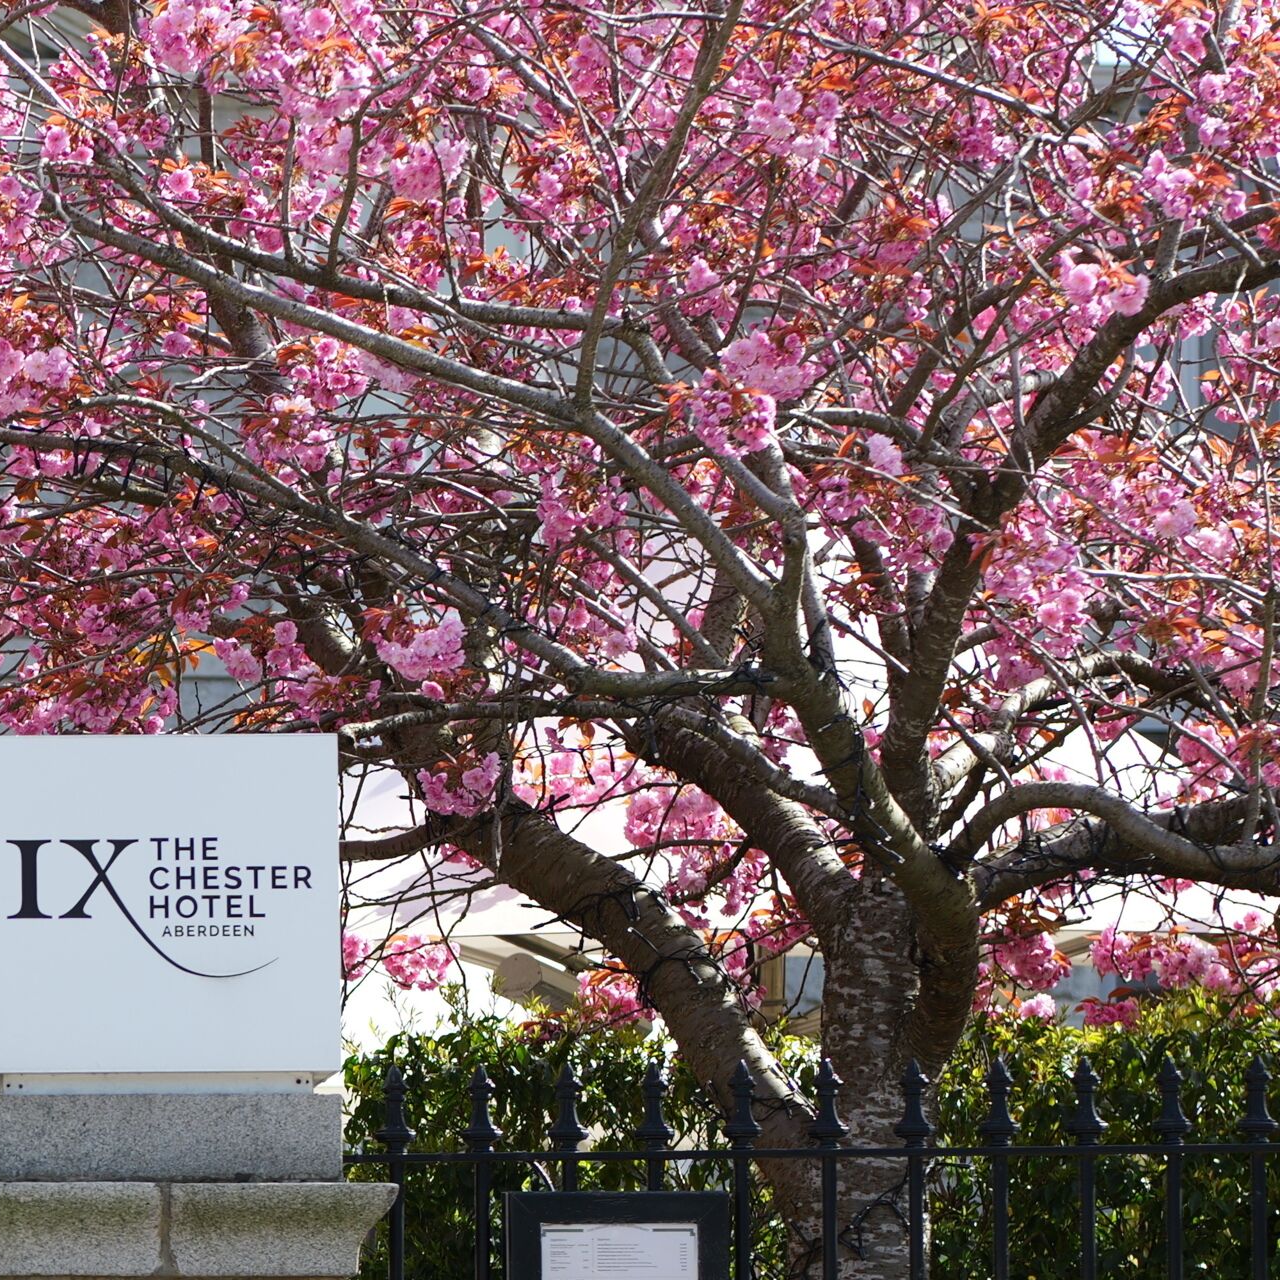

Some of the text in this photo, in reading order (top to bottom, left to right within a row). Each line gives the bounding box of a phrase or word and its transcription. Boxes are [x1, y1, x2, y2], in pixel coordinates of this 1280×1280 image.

[149, 836, 219, 861] THE
[149, 865, 313, 890] CHESTER
[149, 894, 266, 919] HOTEL
[161, 924, 255, 938] ABERDEEN
